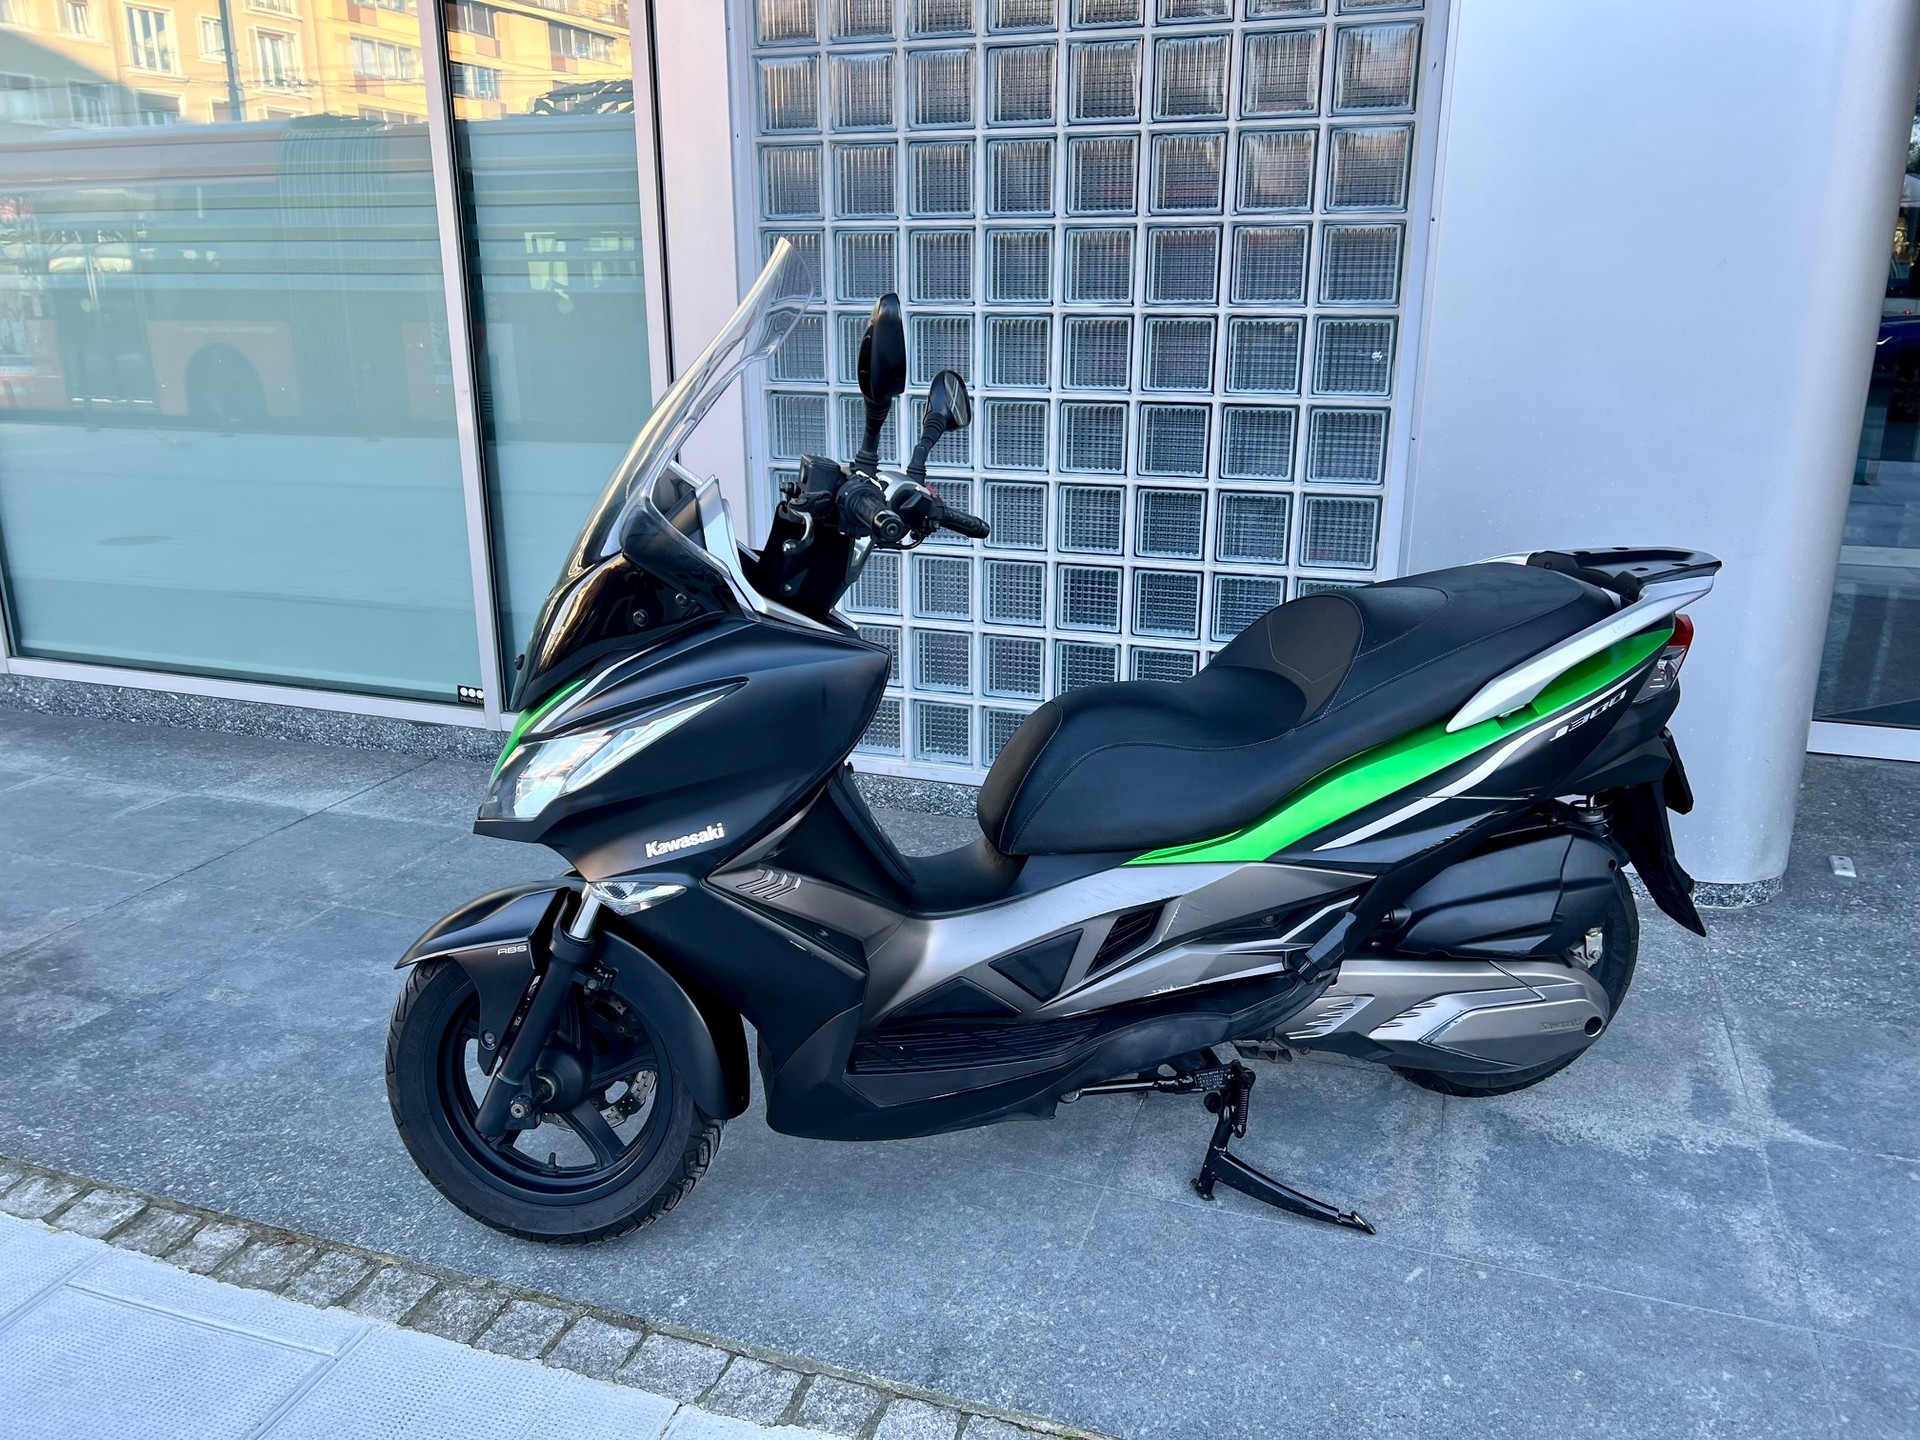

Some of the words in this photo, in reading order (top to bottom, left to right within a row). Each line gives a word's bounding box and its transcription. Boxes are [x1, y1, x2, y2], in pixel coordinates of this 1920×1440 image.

[1549, 689, 1627, 742] J300
[645, 822, 725, 858] Kawasaki
[497, 945, 527, 956] ABS
